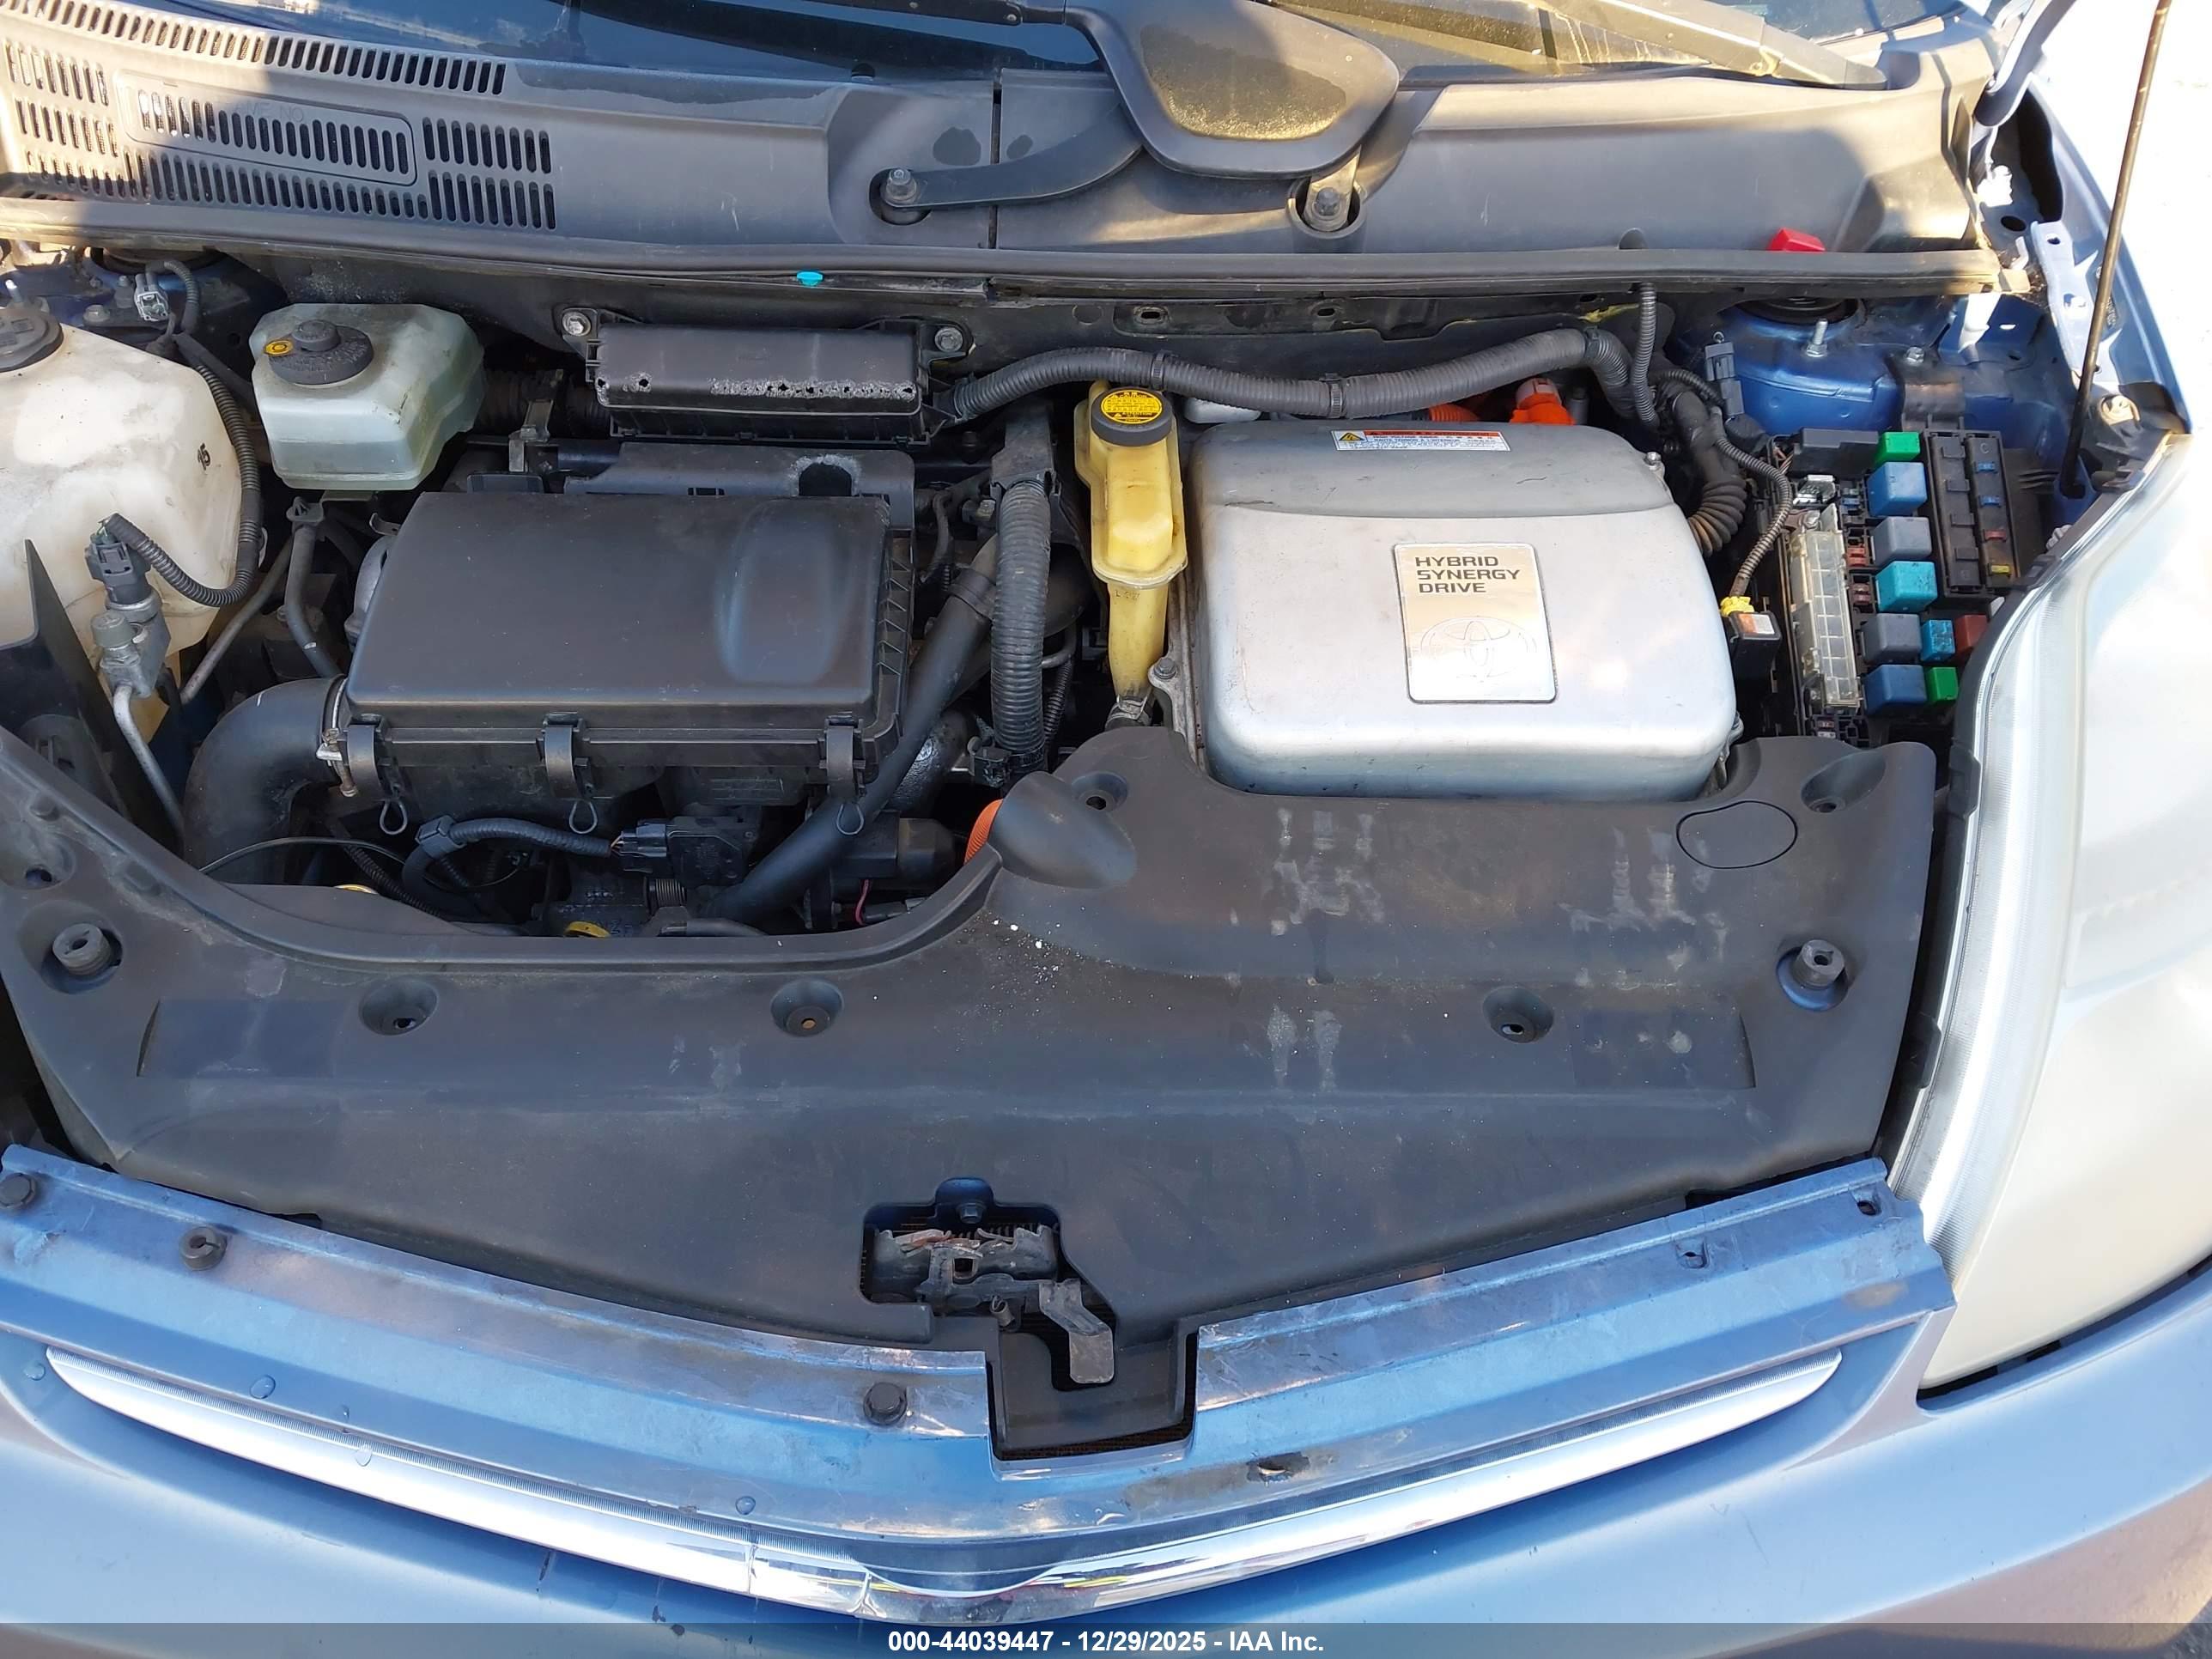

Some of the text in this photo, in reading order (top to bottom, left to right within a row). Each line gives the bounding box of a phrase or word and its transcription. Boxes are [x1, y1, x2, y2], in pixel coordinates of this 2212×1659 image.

[1415, 556, 1498, 567] HYBRID
[1417, 569, 1520, 580] SYNERGY
[1419, 583, 1486, 592] DRIVE
